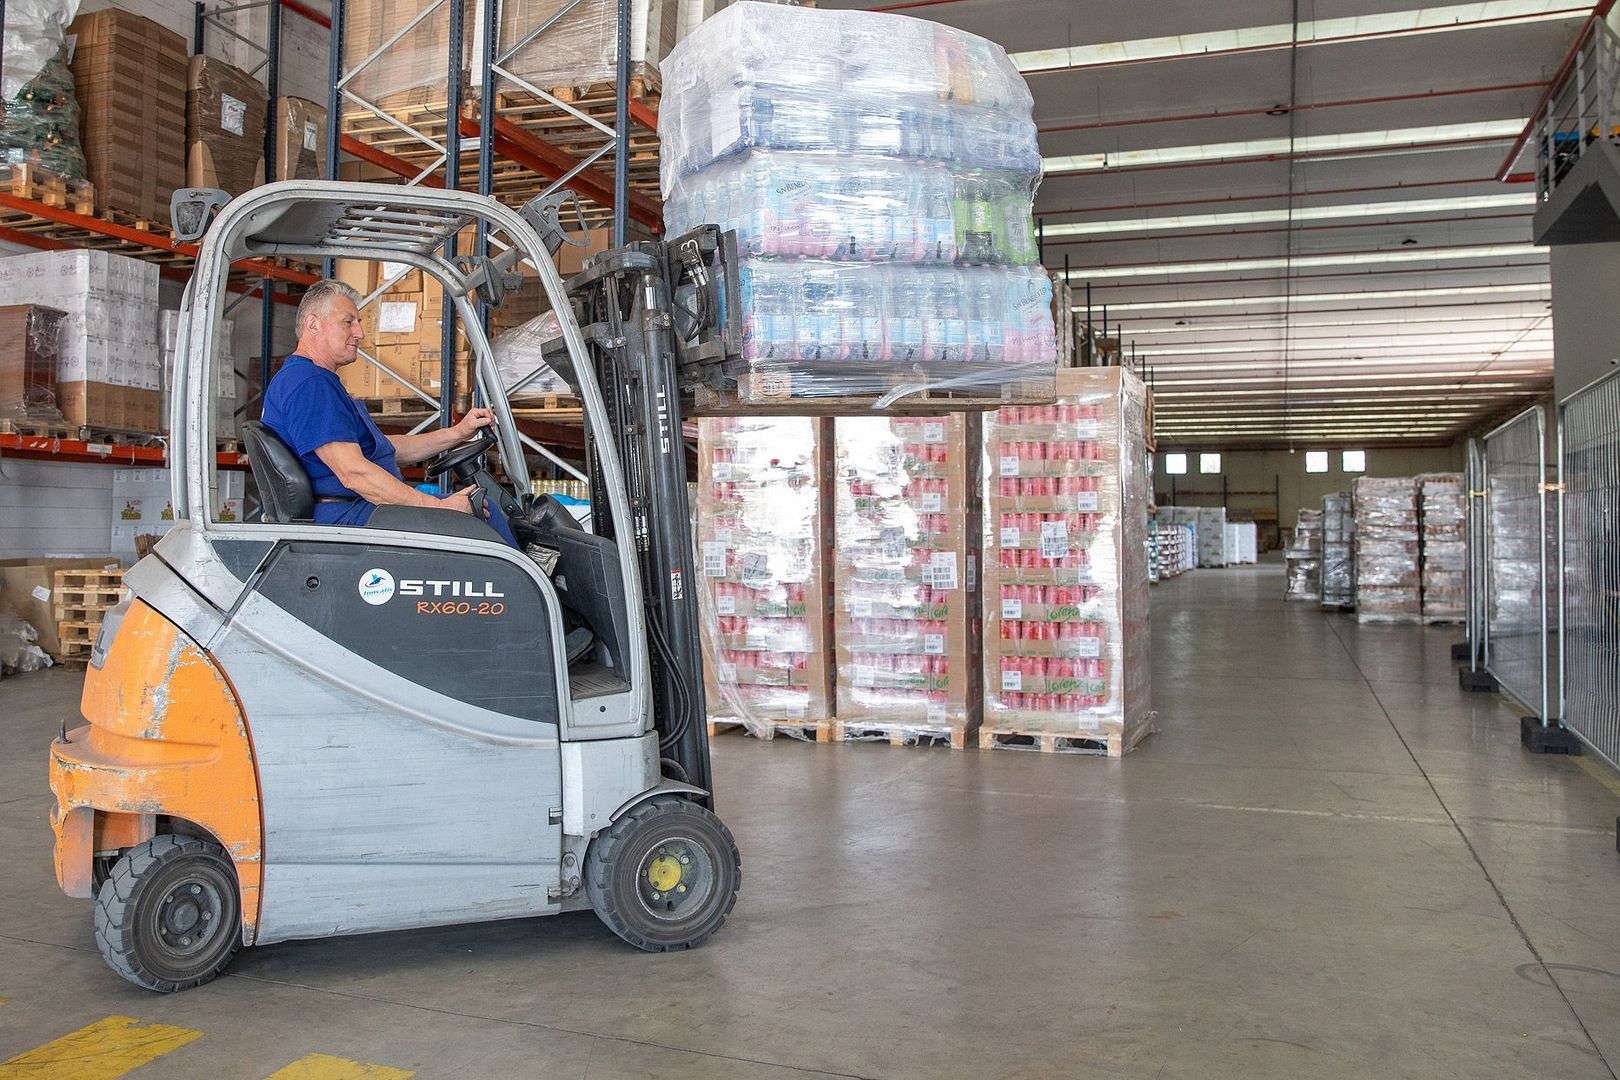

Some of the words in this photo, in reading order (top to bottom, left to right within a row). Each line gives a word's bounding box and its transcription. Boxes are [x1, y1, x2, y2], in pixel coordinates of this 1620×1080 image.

[657, 384, 670, 454] STILL
[400, 580, 504, 597] STILL
[416, 601, 505, 615] RX60-20
